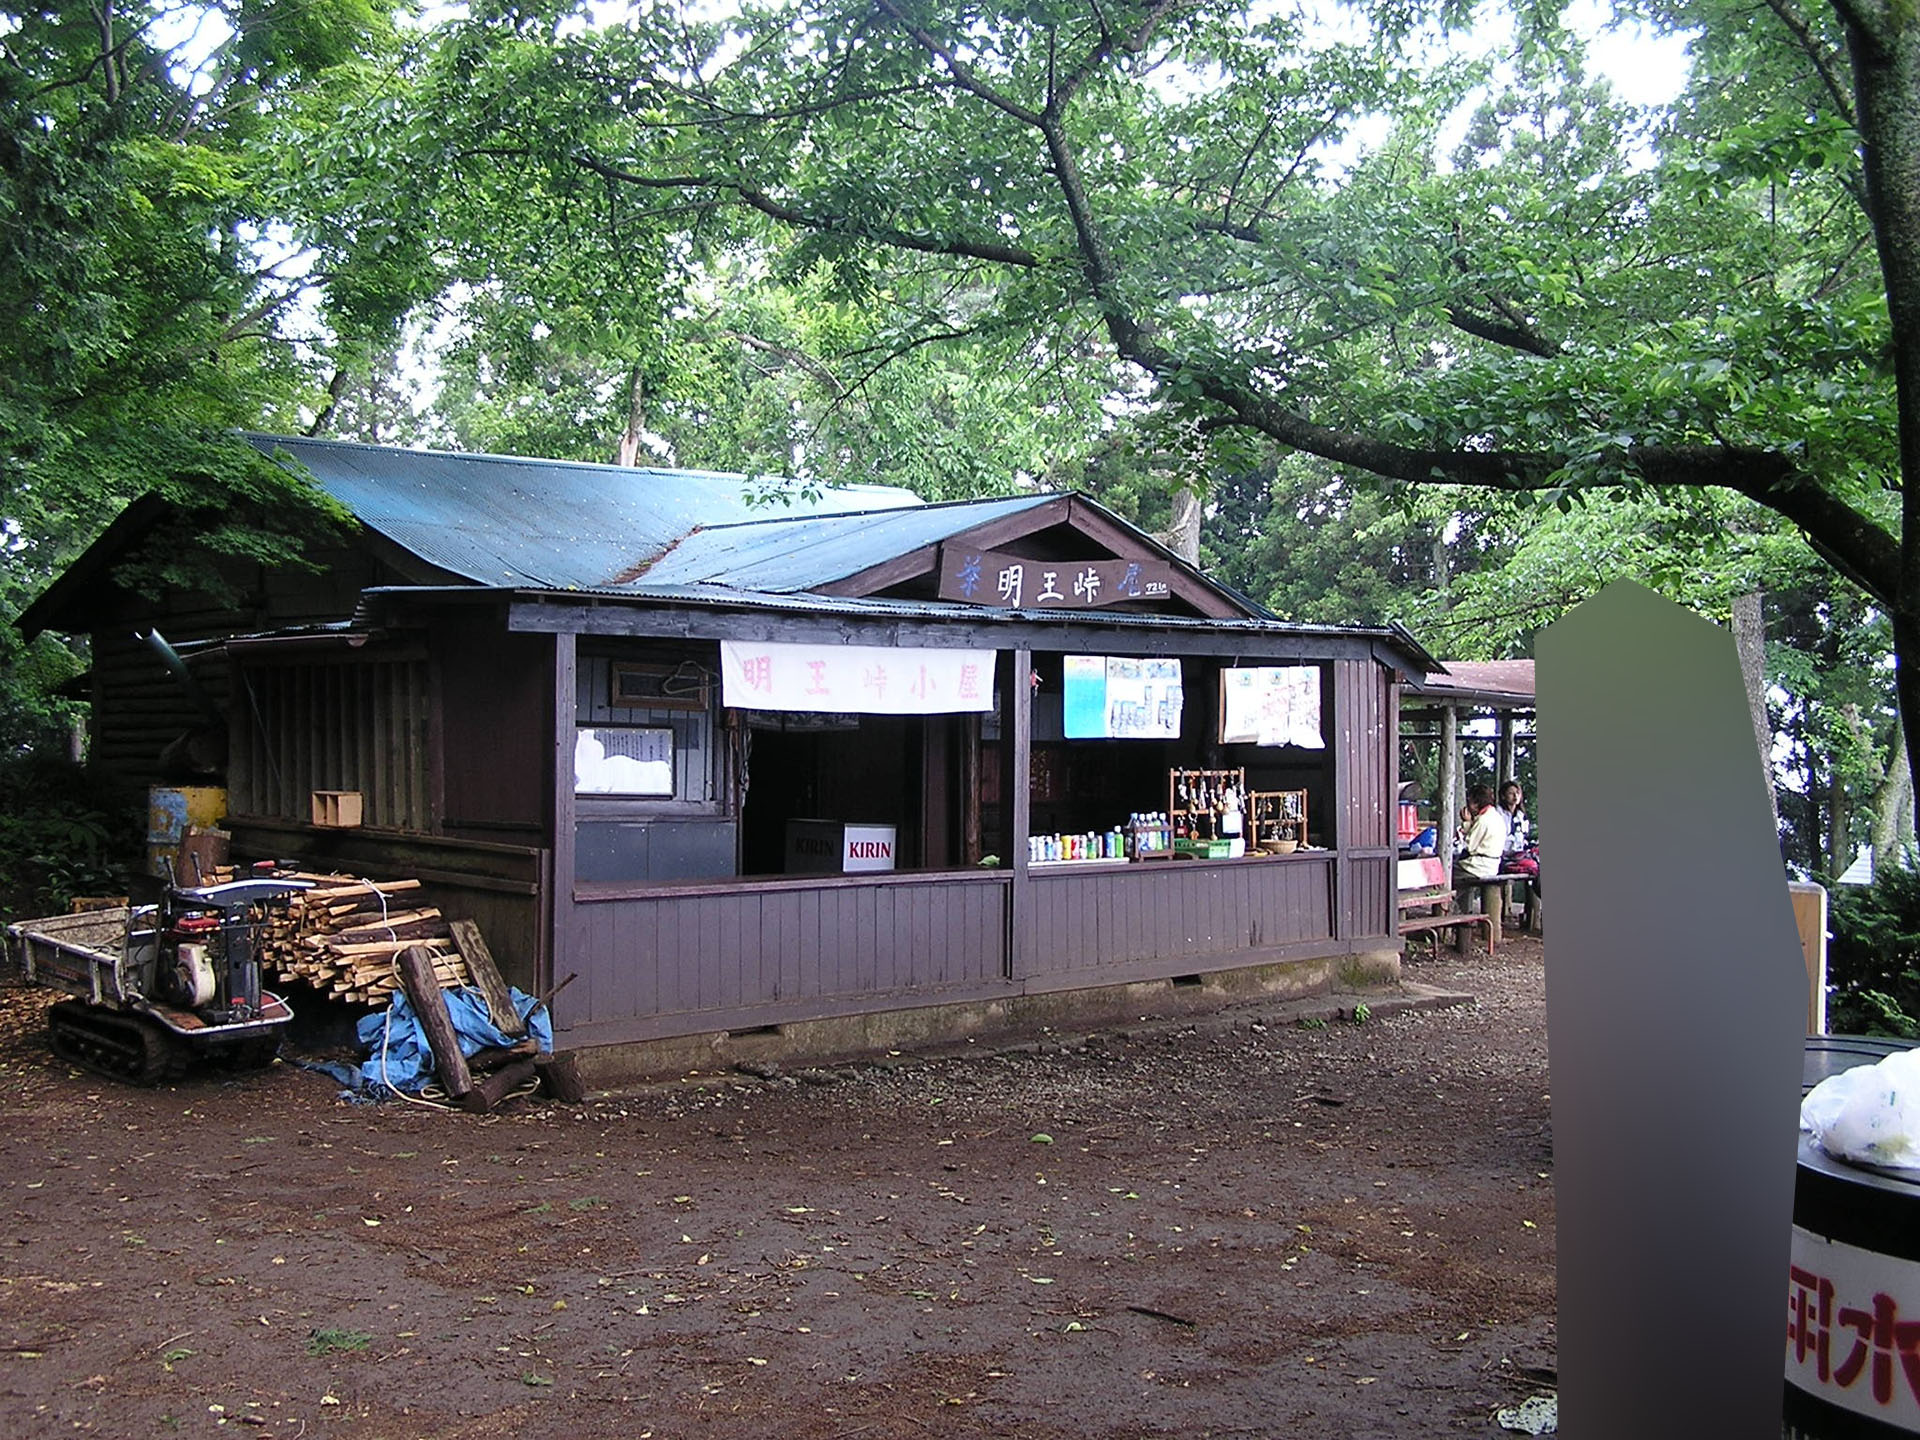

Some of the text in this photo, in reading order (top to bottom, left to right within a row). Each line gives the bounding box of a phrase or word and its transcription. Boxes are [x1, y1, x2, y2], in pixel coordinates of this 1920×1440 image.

[743, 655, 980, 700] 明王峠小屋
[795, 837, 834, 856] KIRIN
[850, 841, 891, 858] KIRIN
